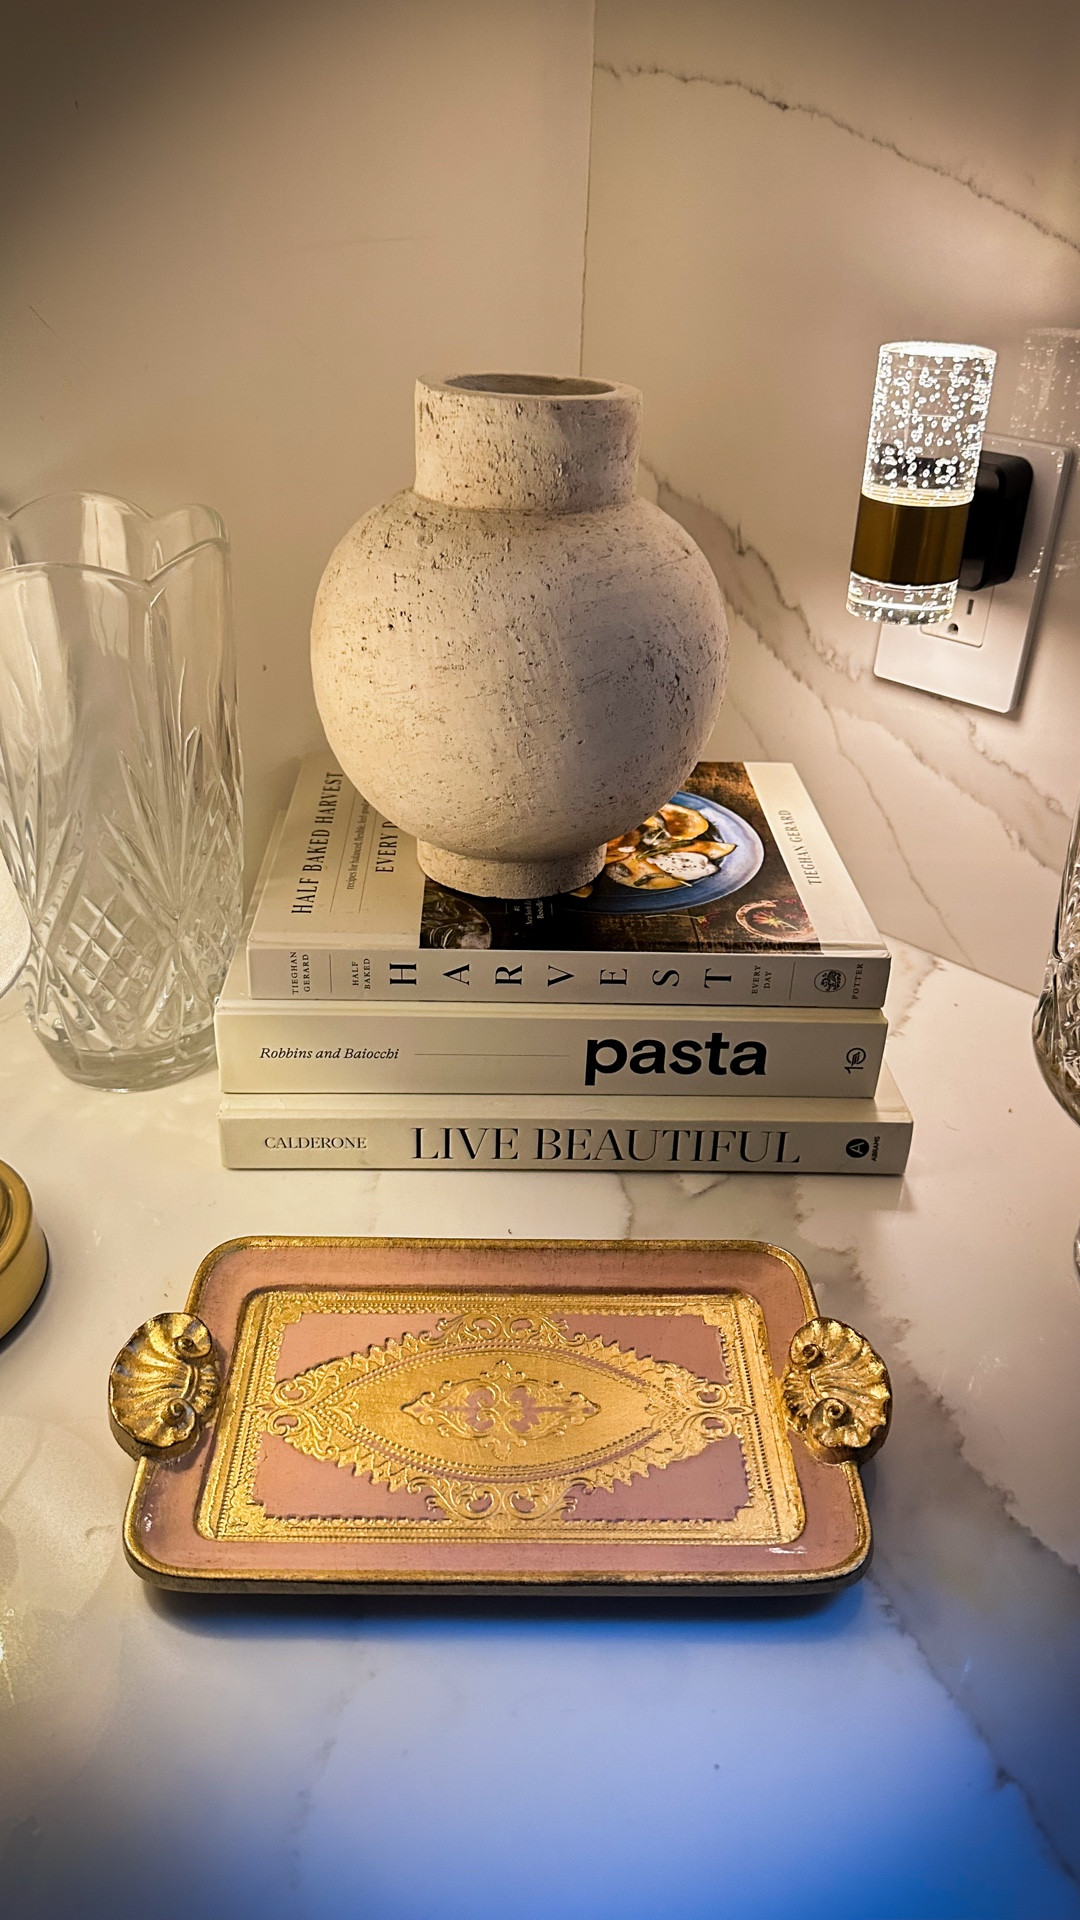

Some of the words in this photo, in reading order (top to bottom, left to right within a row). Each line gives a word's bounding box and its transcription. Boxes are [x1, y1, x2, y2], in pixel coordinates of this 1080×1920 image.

[314, 772, 344, 824] HARVEST
[778, 810, 802, 843] GERARD
[302, 829, 330, 872] BAKED
[375, 833, 398, 873] EVERY
[794, 845, 822, 885] TIEGHAN
[291, 877, 320, 914] HALF
[291, 951, 299, 995] TIEGHAN
[303, 953, 311, 993] GERARD
[363, 957, 371, 990] BAKED
[389, 963, 732, 989] HARVEST
[751, 964, 761, 994] EVERY
[764, 970, 772, 989] DAY
[851, 963, 864, 1000] POTTER
[260, 1047, 313, 1060] Robbins
[315, 1047, 342, 1060] and
[344, 1047, 400, 1060] Baiocchi
[584, 1032, 767, 1086] pasta
[264, 1136, 367, 1150] CALDERONE
[411, 1127, 519, 1160] LIVE
[533, 1128, 800, 1164] BEAUTIFUL
[871, 1136, 881, 1162] ABRAMS
